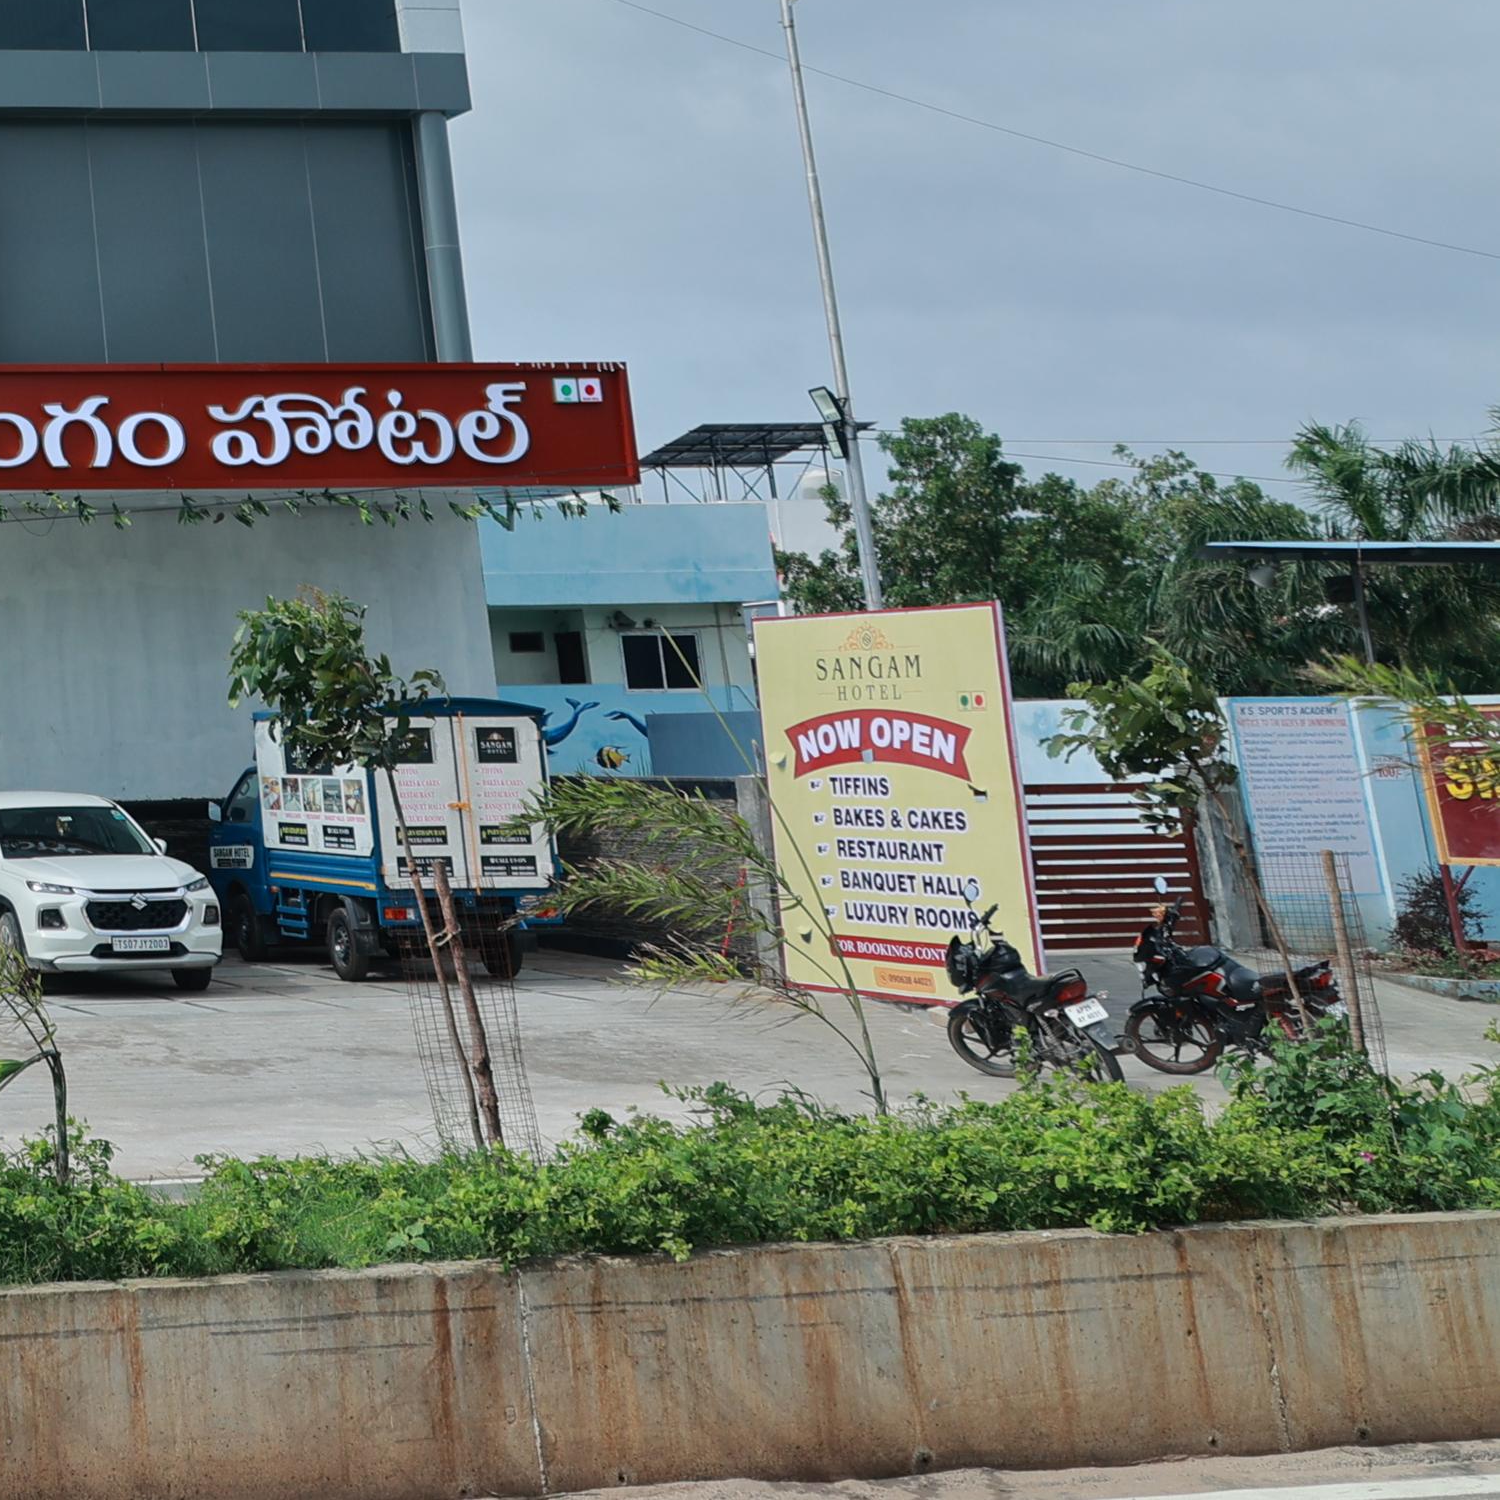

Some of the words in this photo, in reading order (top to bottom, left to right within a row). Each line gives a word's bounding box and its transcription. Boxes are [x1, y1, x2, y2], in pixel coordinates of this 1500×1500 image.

[206, 380, 534, 468] హోటల్
[816, 654, 923, 682] SANGAM
[837, 684, 903, 702] HOTEL
[1258, 706, 1298, 715] SPORTS
[1300, 706, 1338, 715] ACADEMY
[480, 741, 513, 749] SANGAM
[797, 717, 862, 764] NOW
[868, 717, 957, 766] OPEN
[829, 776, 890, 797] TIFFINS
[833, 809, 885, 829] BAKES
[890, 810, 903, 829] &
[907, 811, 968, 831] CAKES
[836, 840, 944, 863] RESTAURANT
[840, 871, 916, 895] BANQUET
[844, 902, 911, 925] LUXURY
[915, 907, 979, 931] ROOMS
[117, 938, 169, 950] TS07JY2003
[856, 941, 914, 959] BOOKINGS
